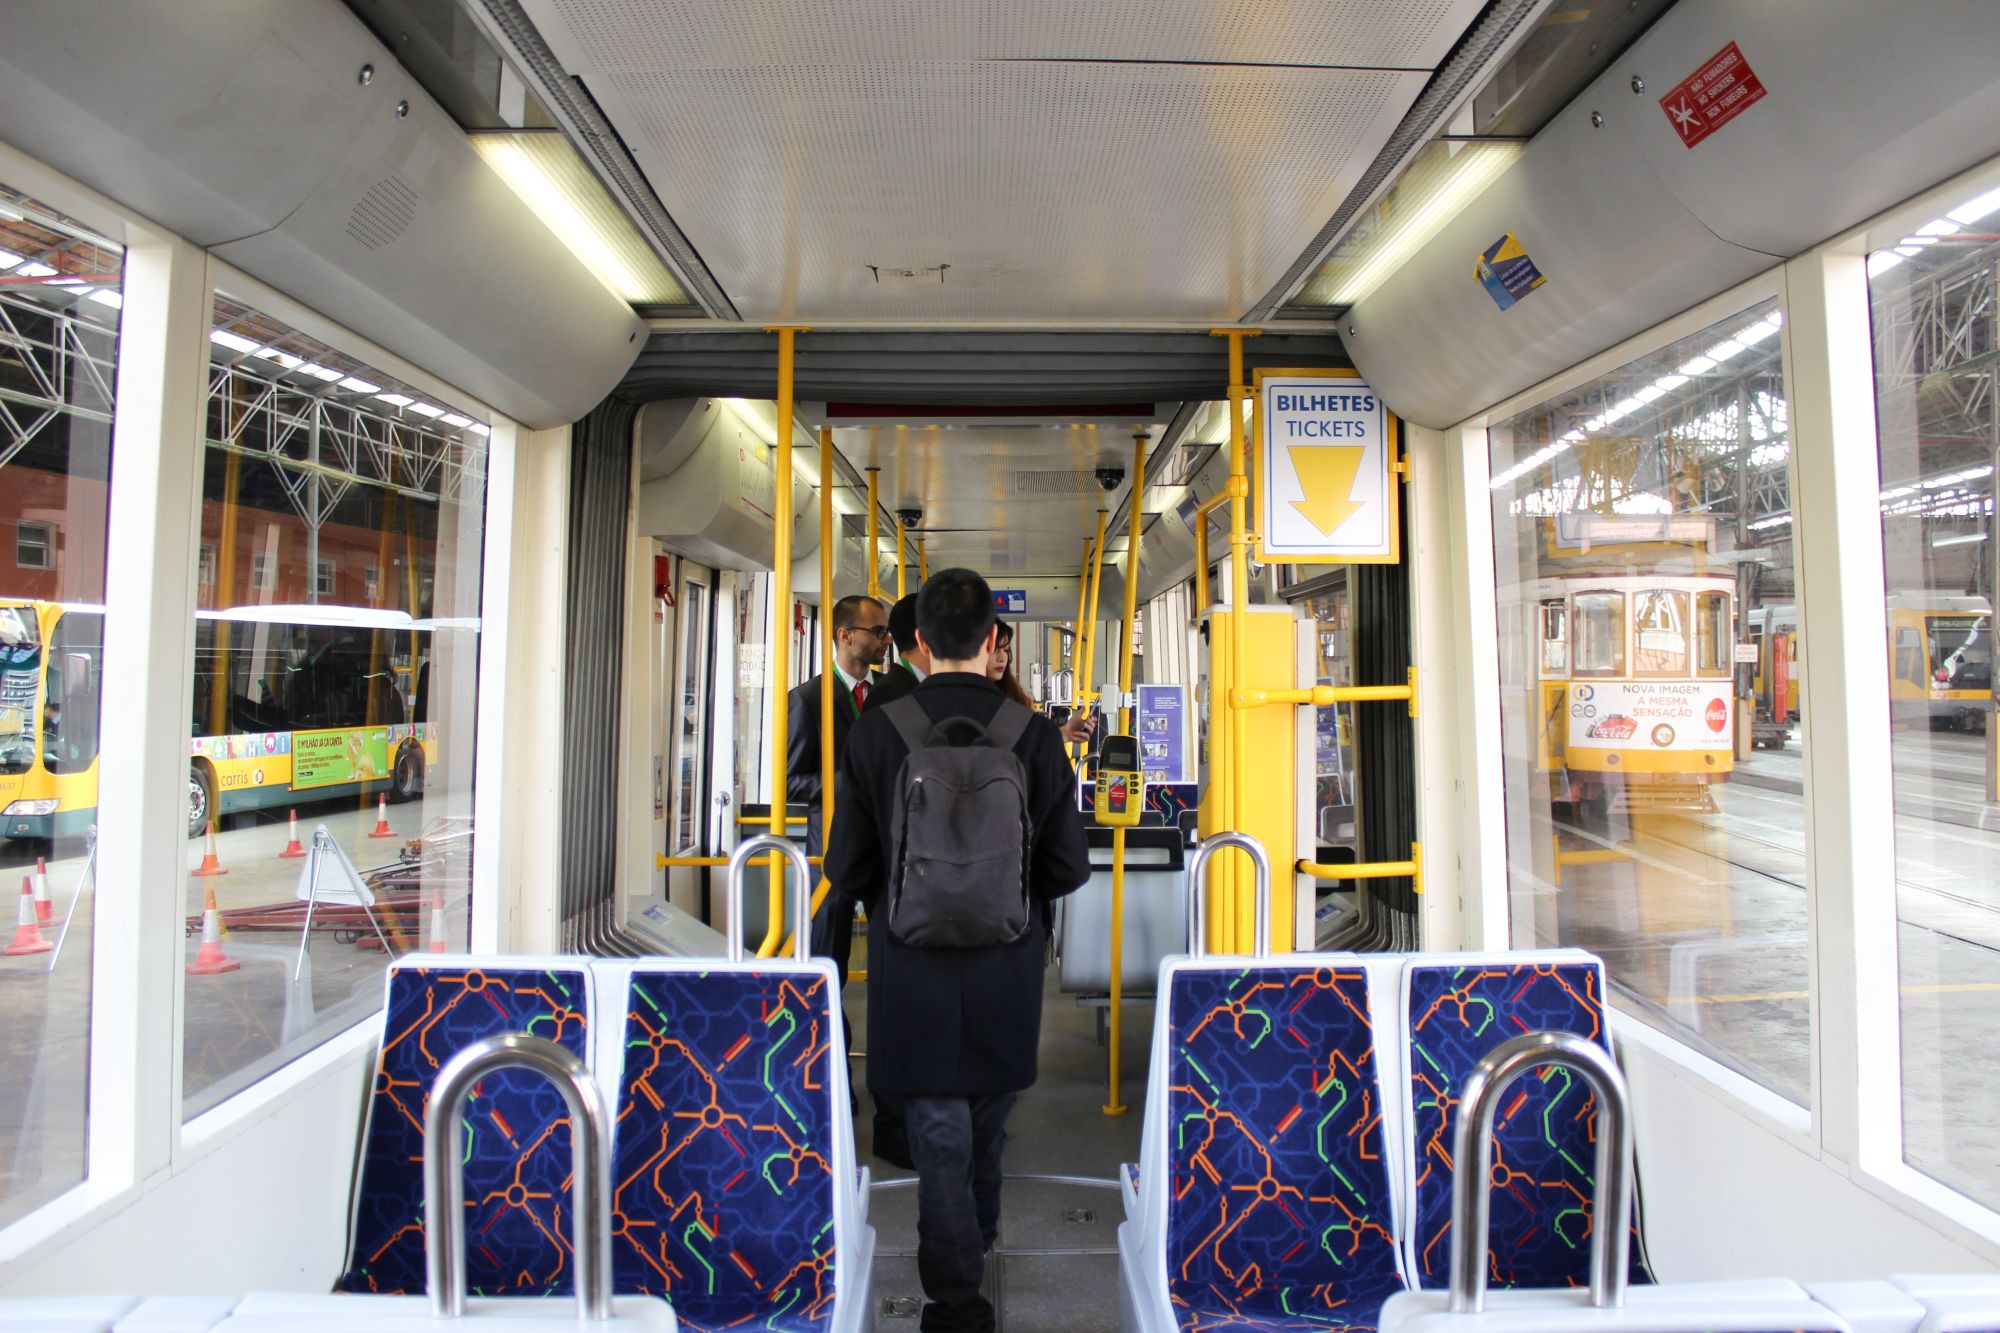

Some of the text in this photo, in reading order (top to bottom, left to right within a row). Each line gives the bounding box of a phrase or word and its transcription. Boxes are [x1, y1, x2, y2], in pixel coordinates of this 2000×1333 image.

[1704, 53, 1737, 83] FUMADORES
[1697, 94, 1709, 107] NO
[1708, 74, 1735, 98] SMOKERS
[1706, 105, 1721, 119] NON
[1721, 86, 1748, 109] FUMEURS
[1277, 395, 1375, 412] BILHETES
[1286, 420, 1365, 438] TICKETS
[1622, 684, 1701, 694] NOVA IMAGEM
[1637, 697, 1688, 706] A MESMA
[1632, 705, 1693, 719] SENSAÇÃO
[221, 773, 248, 786] carris
